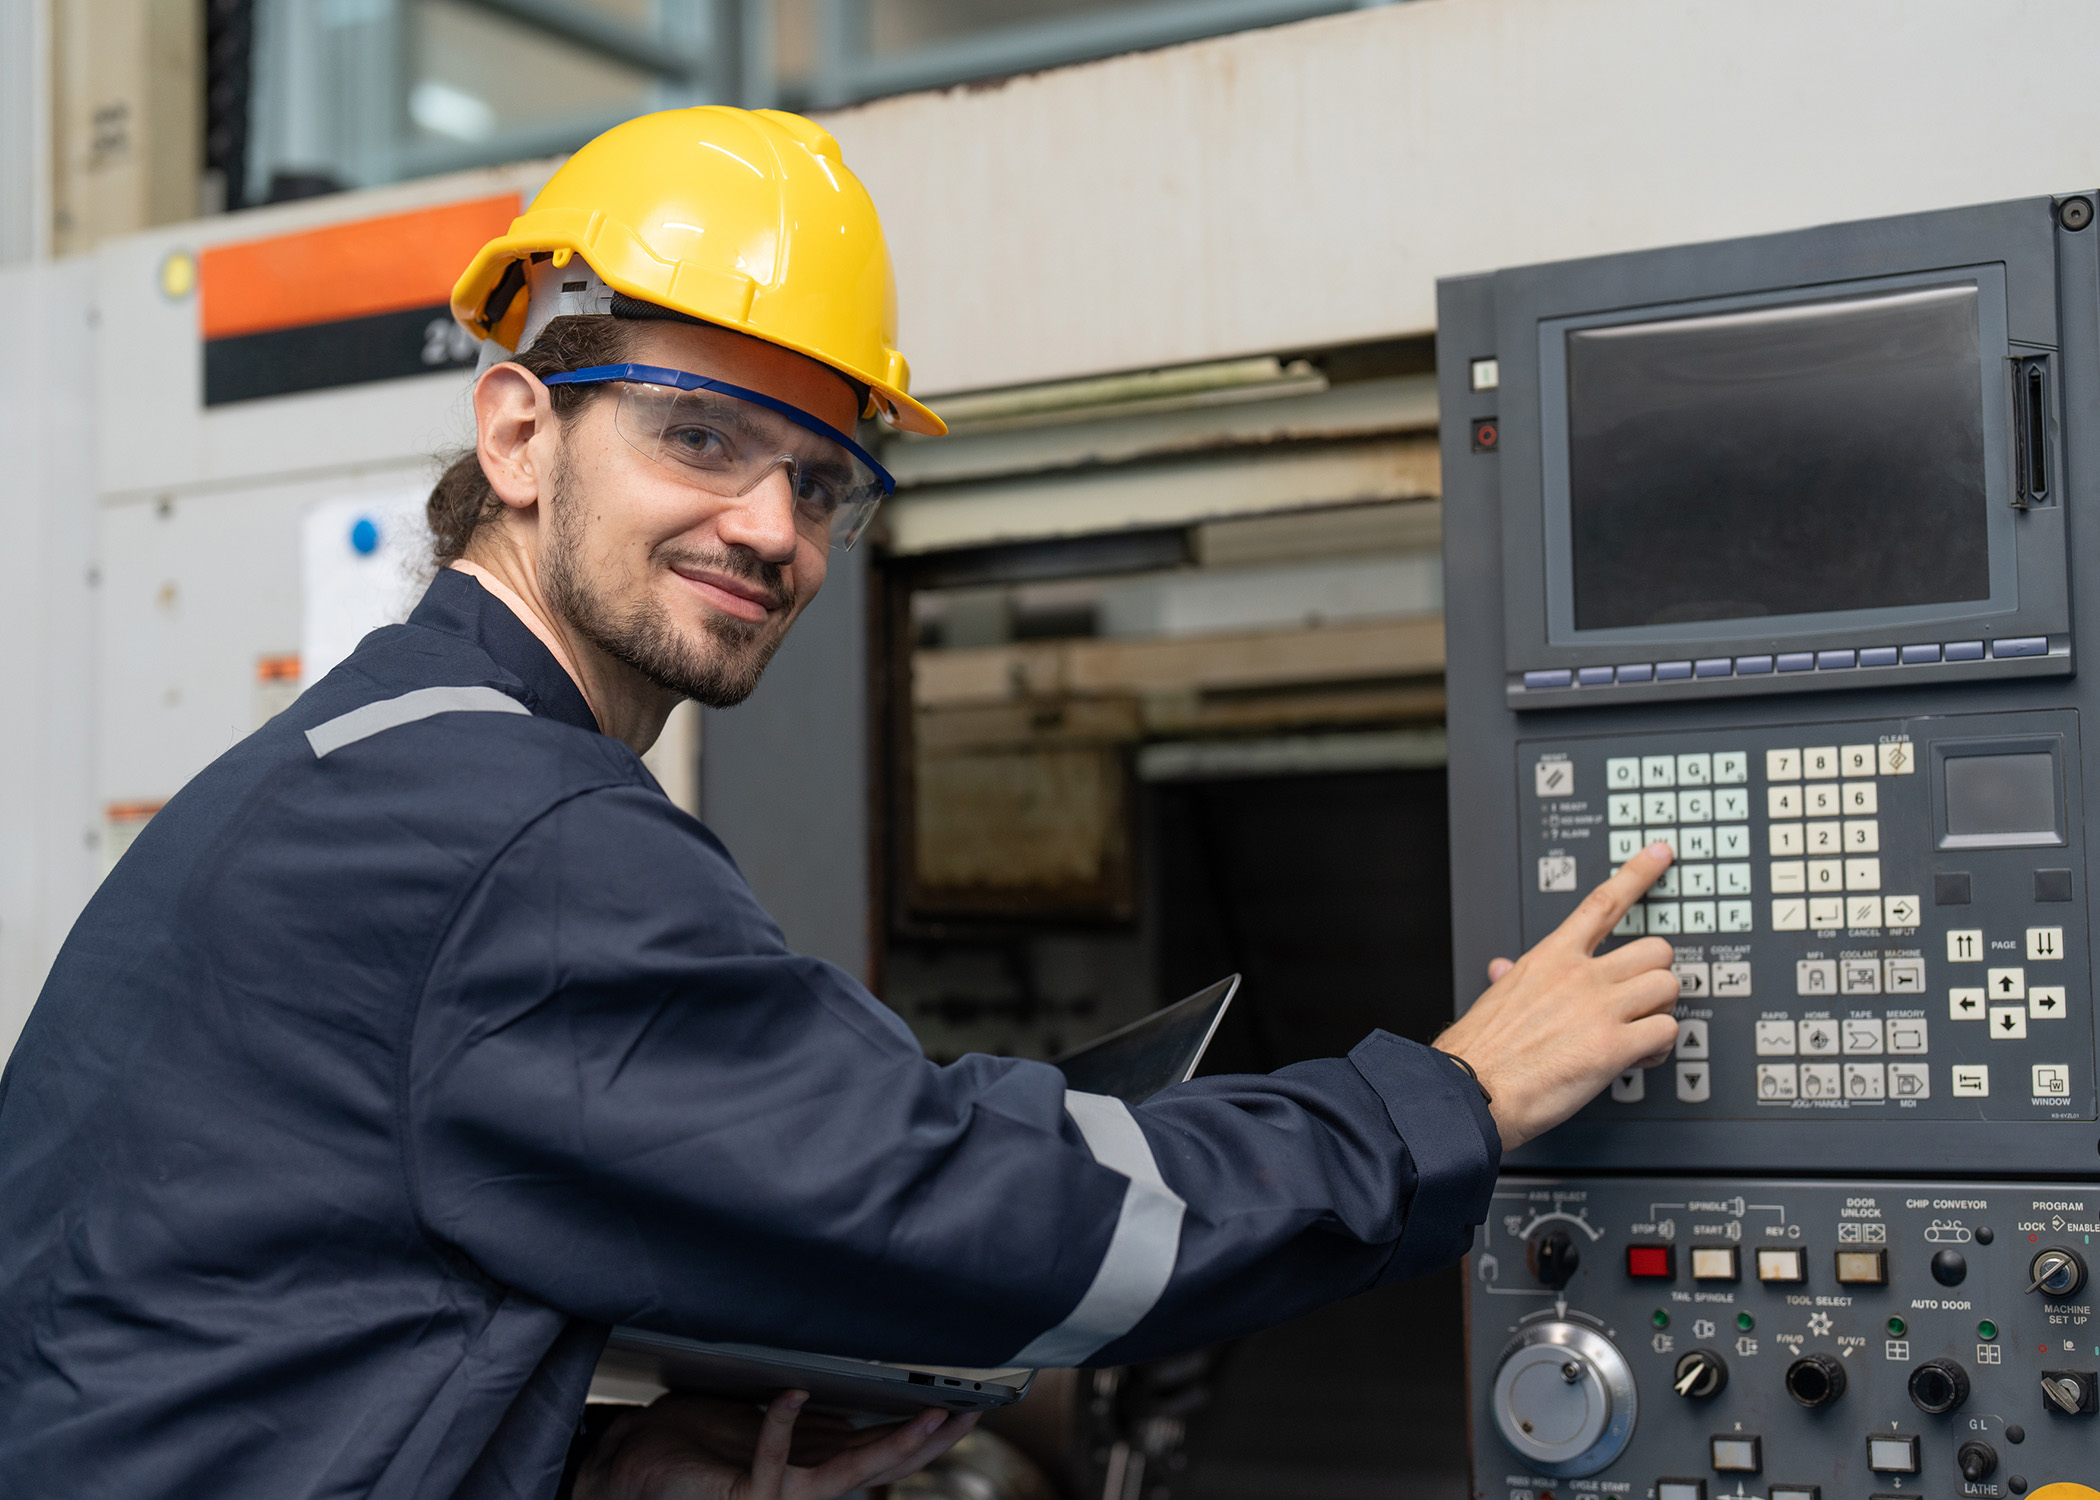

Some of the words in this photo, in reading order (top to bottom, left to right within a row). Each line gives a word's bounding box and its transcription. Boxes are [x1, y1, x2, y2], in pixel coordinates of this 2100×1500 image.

[1879, 733, 1910, 744] CLEAR
[1780, 758, 1788, 771] 7
[1816, 756, 1825, 769] 8
[1854, 754, 1863, 768] 9
[1652, 765, 1664, 778] N
[1688, 763, 1700, 777] G
[1724, 761, 1735, 774] P
[1726, 797, 1736, 811] Y
[1780, 796, 1788, 808] 4
[1818, 794, 1826, 807] 5
[1855, 792, 1864, 805] 6
[1620, 803, 1629, 817] X
[1655, 801, 1665, 815] Z
[1690, 799, 1700, 813] C
[1728, 836, 1738, 848] V
[1783, 832, 1789, 846] 1
[1819, 831, 1828, 845] 2
[1856, 829, 1866, 844] 3
[1620, 840, 1631, 854] U
[1691, 837, 1702, 850] H
[1693, 874, 1702, 887] T
[1729, 873, 1738, 886] L
[1658, 912, 1669, 925] K
[1694, 911, 1704, 924] R
[1730, 910, 1740, 922] F
[1848, 928, 1881, 937] CANCEL
[1889, 927, 1916, 936] INPUT
[1991, 940, 2017, 950] PAGE
[1840, 950, 1878, 960] COOLANT
[1884, 948, 1922, 958] MACHINE
[1762, 1011, 1789, 1020] RAPID
[1805, 1010, 1831, 1019] HOME
[1850, 1010, 1873, 1018] TAPE
[1886, 1009, 1926, 1018] MEMORY
[1900, 1100, 1917, 1108] MDI
[2031, 1098, 2072, 1106] WINDOW
[1688, 1202, 1728, 1212] SPINDLE
[1846, 1198, 1876, 1208] DOOR
[1906, 1198, 1930, 1210] CHIP
[1932, 1199, 1988, 1210] CONVEYOR
[2032, 1201, 2084, 1212] PROGRAM
[1841, 1208, 1882, 1219] UNLOCK
[1631, 1224, 1656, 1235] STOP
[1693, 1225, 1724, 1236] START
[1766, 1226, 1785, 1237] REV
[2018, 1222, 2046, 1232] LOCK
[2067, 1223, 2100, 1233] ENABLE
[1671, 1291, 1692, 1302] TAIL
[1694, 1292, 1734, 1304] SPINDLE
[1786, 1295, 1812, 1306] TOOL
[1815, 1296, 1853, 1307] SELECT
[1911, 1299, 1938, 1310] AUTO
[1942, 1300, 1972, 1310] DOOR
[2044, 1304, 2092, 1315] MACHINE
[2048, 1315, 2070, 1324] SET
[2073, 1316, 2088, 1325] UP
[1734, 1421, 1742, 1432] X
[1891, 1420, 1899, 1430] Y
[1569, 1480, 1598, 1492] CYCLE
[1601, 1481, 1631, 1493] START
[1964, 1483, 1998, 1496] LATHE
